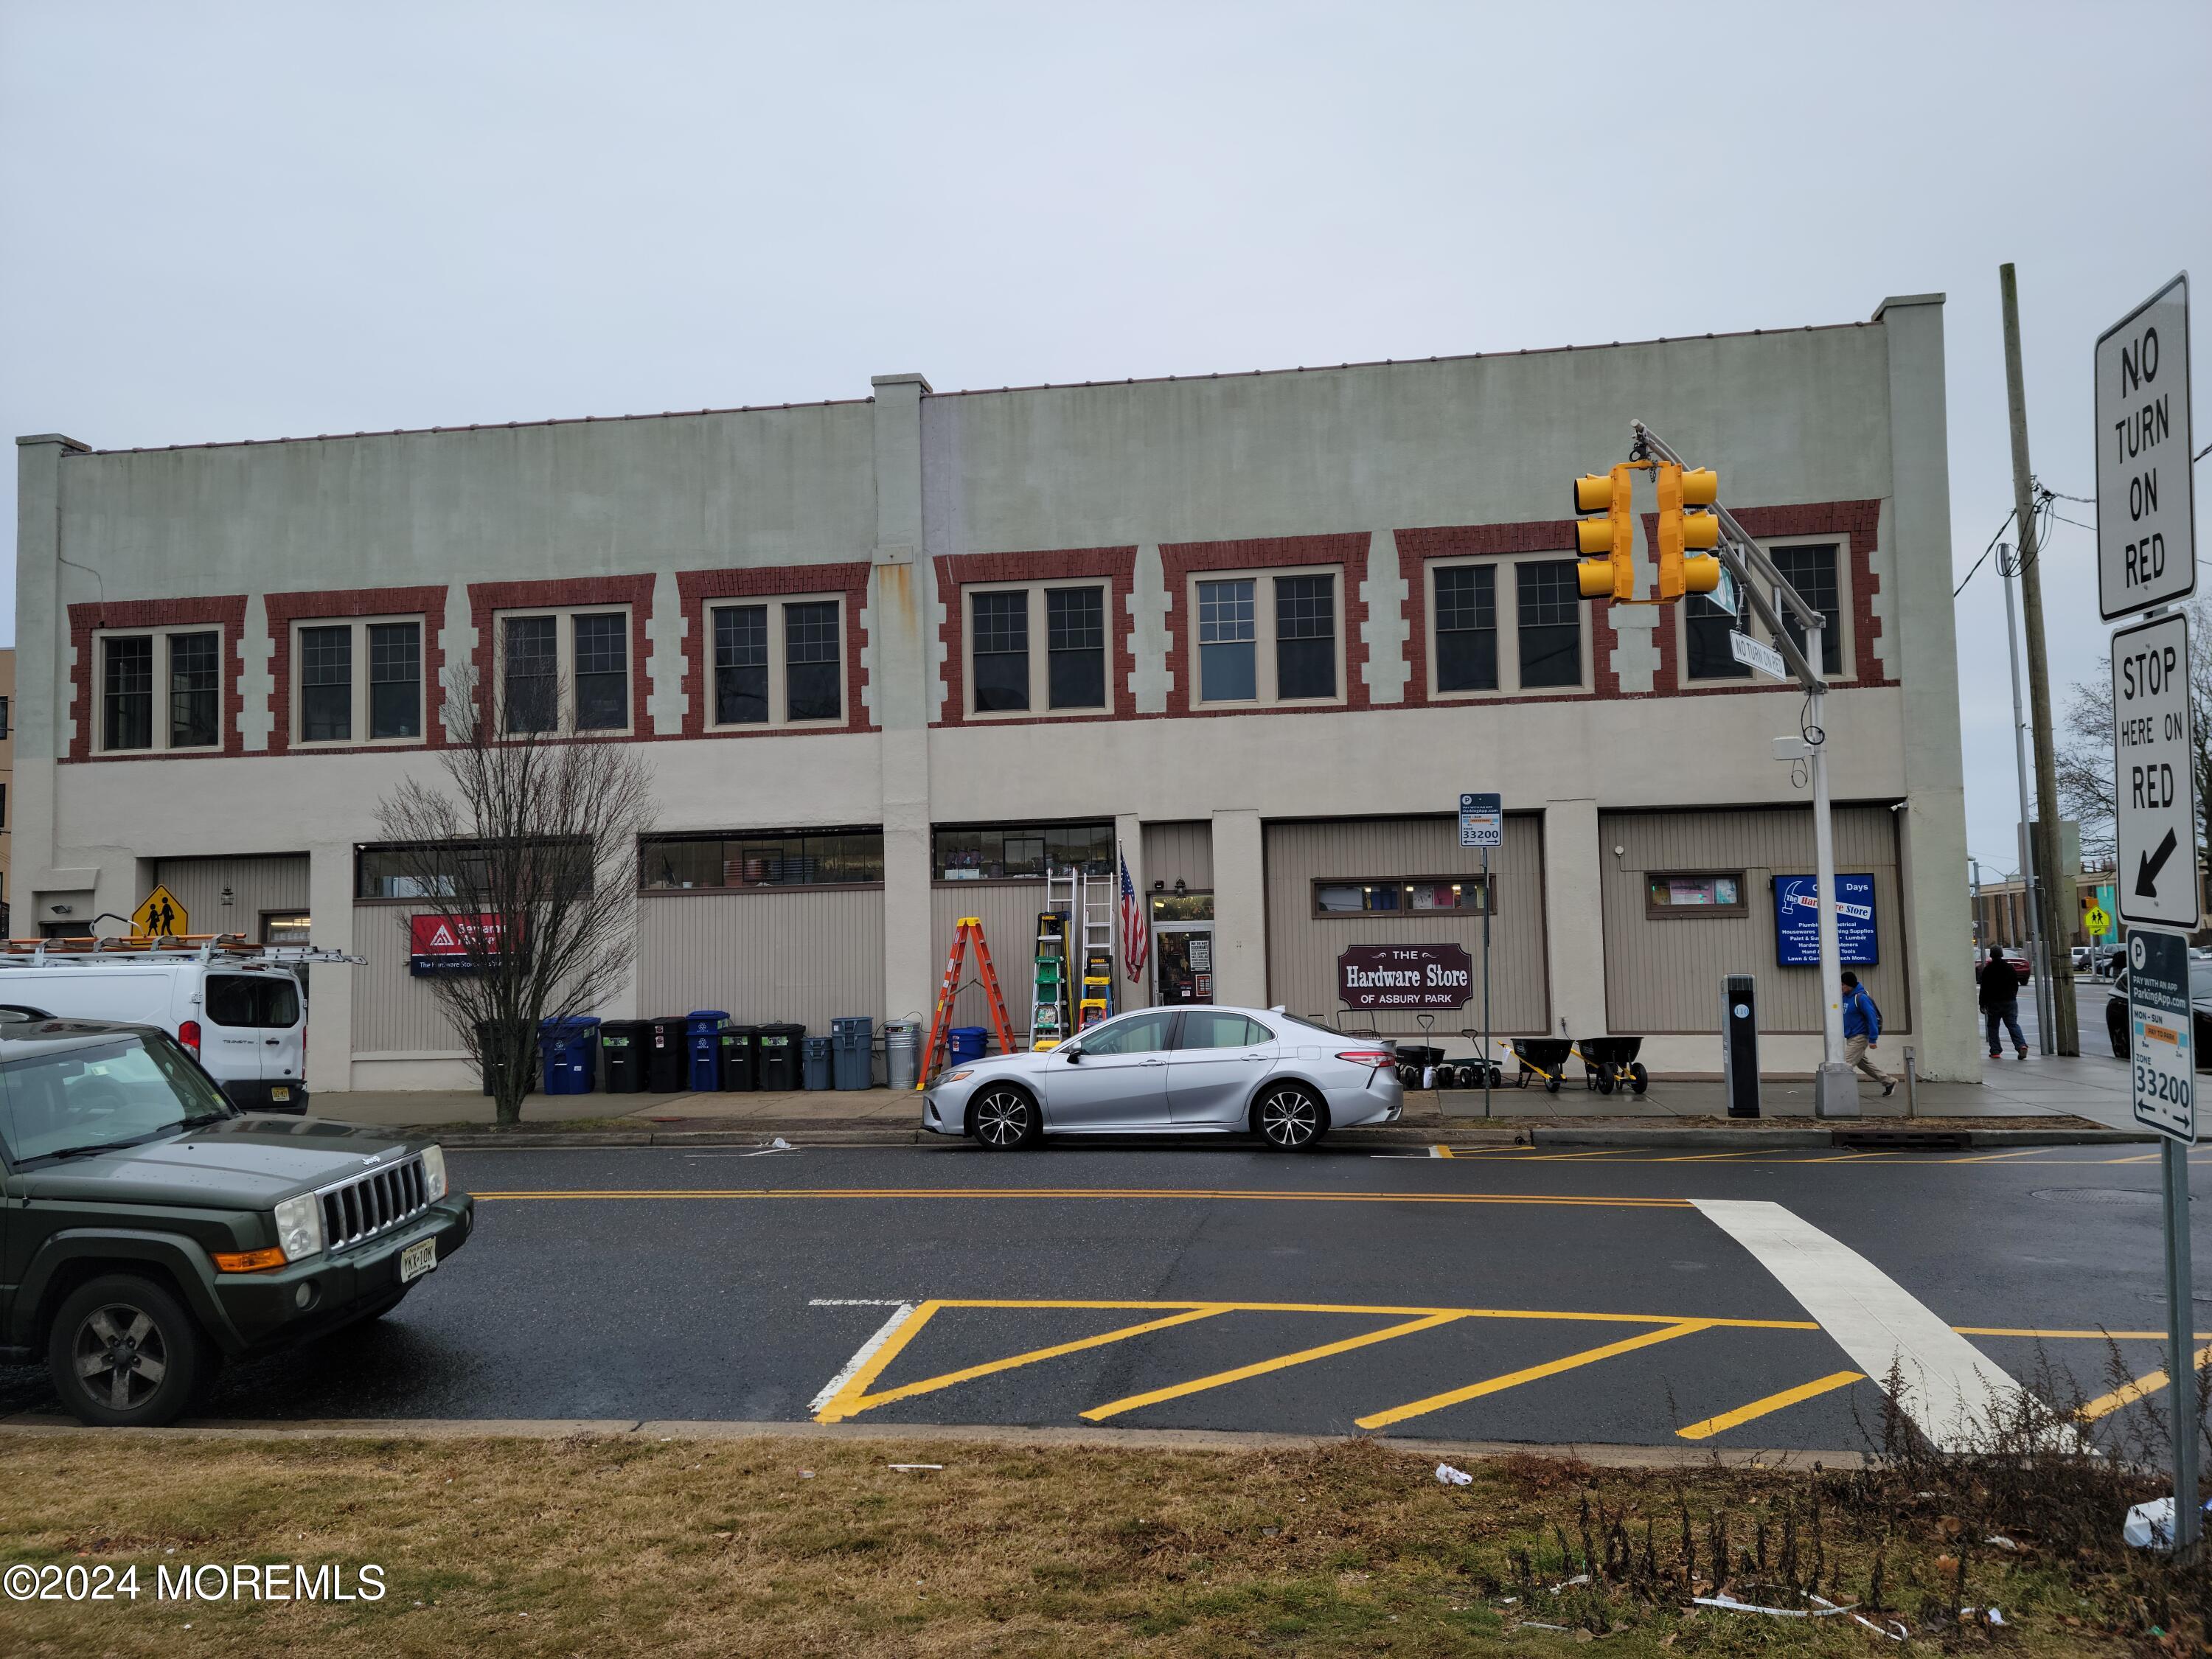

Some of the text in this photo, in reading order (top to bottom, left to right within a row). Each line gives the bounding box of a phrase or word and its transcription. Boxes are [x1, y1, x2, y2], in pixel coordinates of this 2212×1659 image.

[2122, 327, 2159, 399] NO
[2115, 394, 2169, 464] TURN
[2130, 467, 2157, 521] ON
[2126, 532, 2165, 588] RED
[1736, 639, 1783, 674] NO TURN ON RED
[2124, 646, 2176, 700] STOP
[2121, 712, 2183, 747] HERE ON
[2132, 763, 2174, 809] RED
[1463, 830, 1498, 838] 33200
[1846, 883, 1868, 891] Days
[1787, 894, 1798, 902] The
[1846, 905, 1868, 917] Store
[1392, 950, 1419, 959] THE
[1346, 964, 1468, 987] Hardware Store
[2133, 975, 2178, 992] PAY WITH AN APP
[1360, 994, 1452, 1004] OF ASBURY PARK
[2133, 987, 2186, 1009] ParkingApp.com
[2135, 1009, 2146, 1019] MON
[2152, 1015, 2163, 1024] SUN
[2163, 1032, 2174, 1040] PARK
[2136, 1053, 2152, 1065] ZONE
[2137, 1065, 2189, 1108] 33200
[361, 1155, 381, 1166] Jeep
